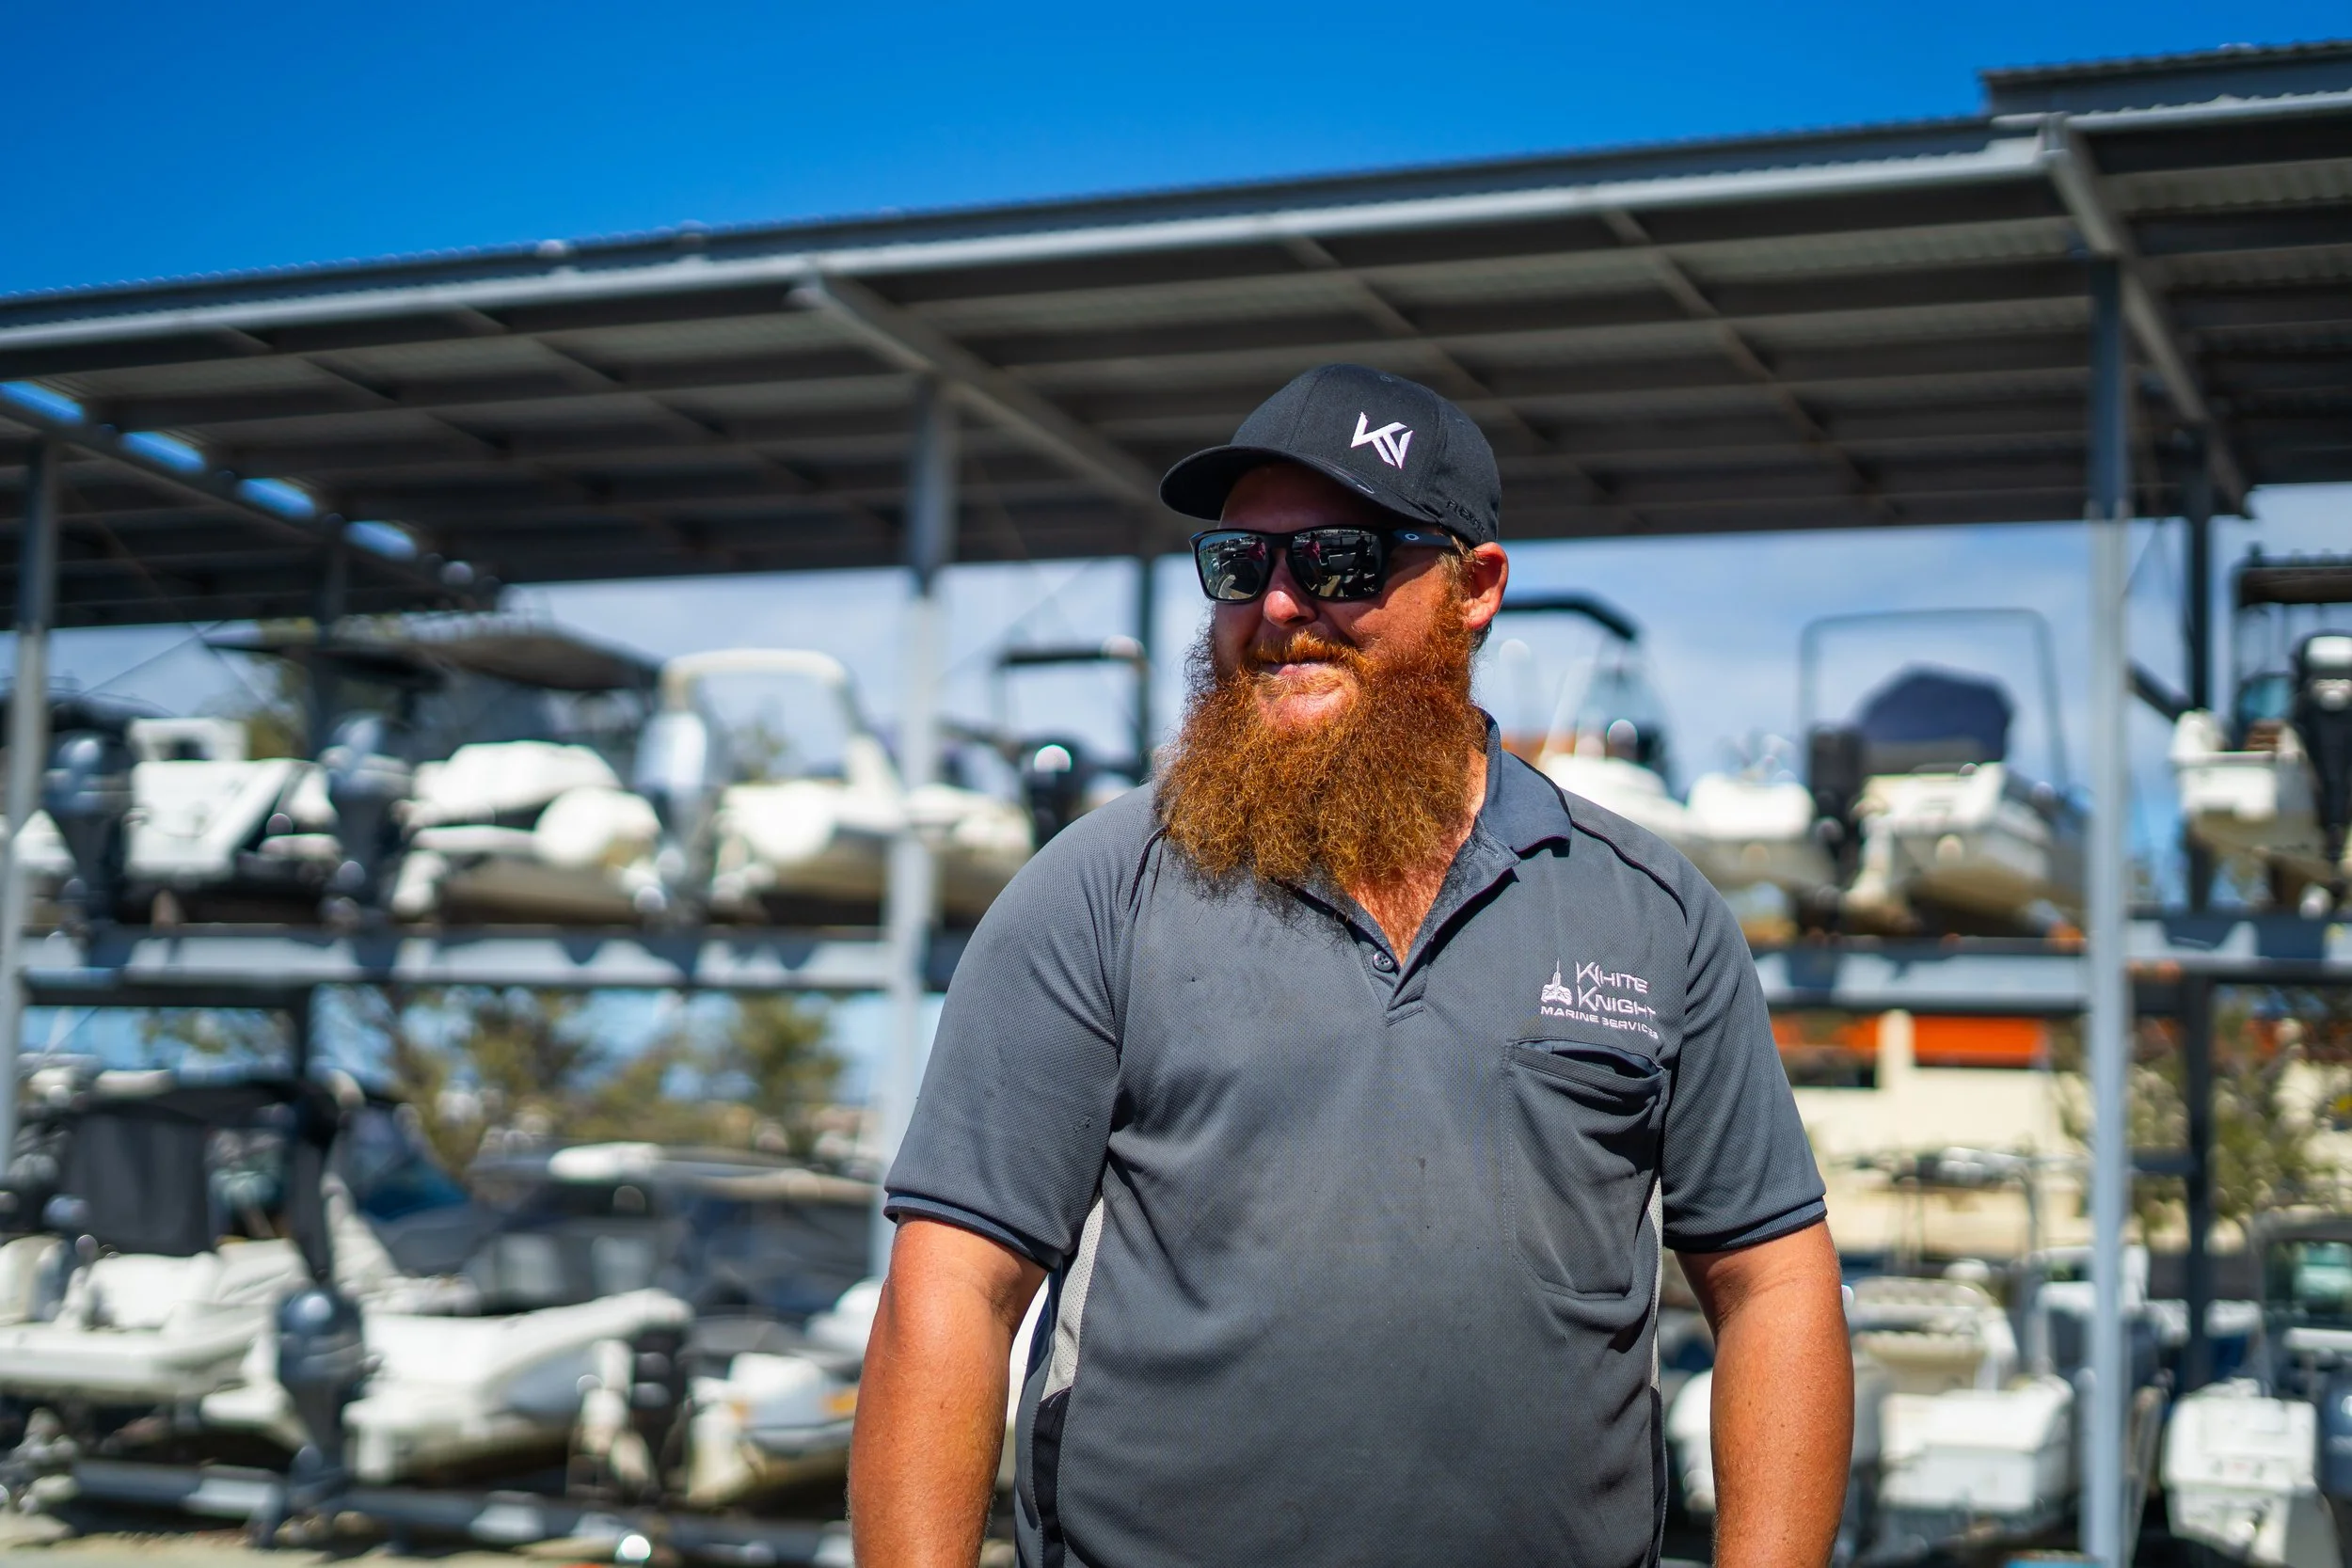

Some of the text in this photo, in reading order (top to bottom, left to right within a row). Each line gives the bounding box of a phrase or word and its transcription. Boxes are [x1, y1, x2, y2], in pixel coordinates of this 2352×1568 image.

[1577, 985, 1656, 1021] KNIGHT
[1540, 1006, 1659, 1039] MARINE SERVICES
